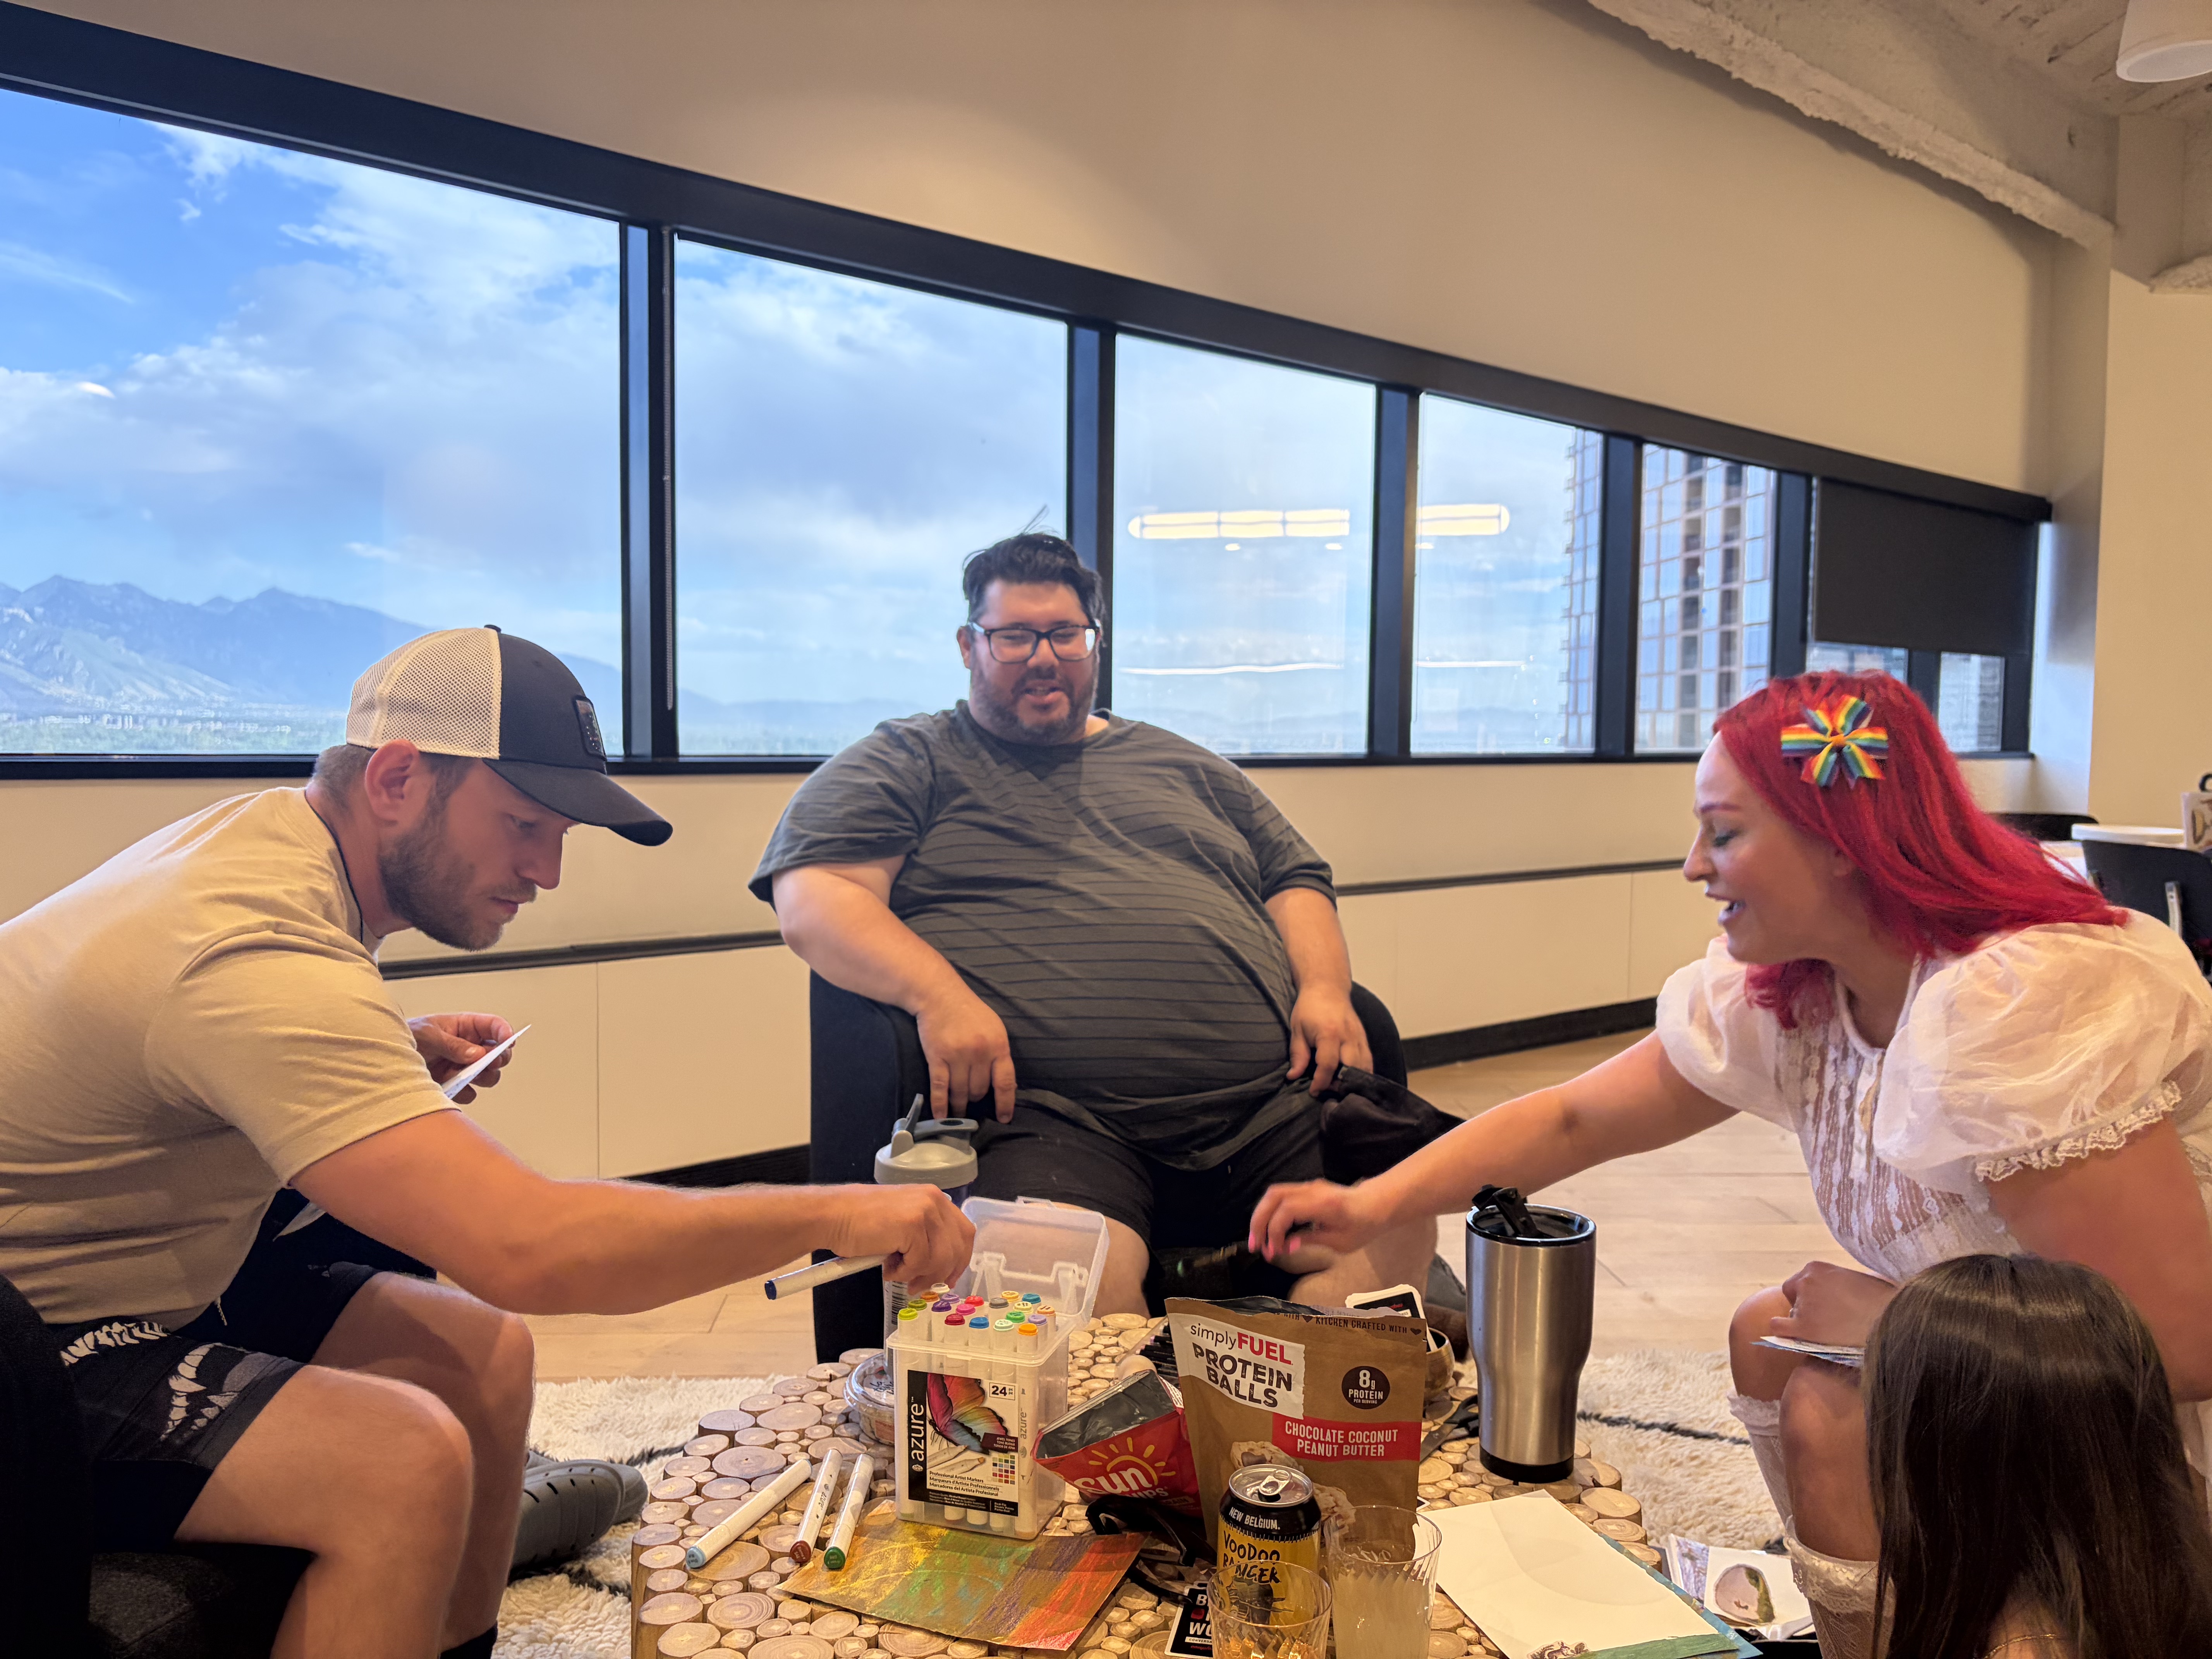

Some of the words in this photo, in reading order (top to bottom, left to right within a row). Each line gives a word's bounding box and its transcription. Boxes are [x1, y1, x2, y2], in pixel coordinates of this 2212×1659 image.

[1316, 1317, 1348, 1328] KITCHEN
[1352, 1320, 1386, 1331] CRAFTED
[1389, 1324, 1407, 1333] WITH
[1192, 1342, 1292, 1391] PROTEIN
[1206, 1366, 1278, 1408] BALLS
[1359, 1370, 1375, 1389] 8g
[991, 1385, 1007, 1396] 24
[1348, 1389, 1383, 1400] PROTEIN
[911, 1403, 924, 1461] azure
[1285, 1420, 1344, 1443] CHOCOLATE
[1348, 1429, 1398, 1443] COCONUT
[1297, 1439, 1338, 1457] PEANUT
[1342, 1444, 1384, 1457] BUTTER
[970, 1482, 1000, 1491] Professionnels
[1229, 1507, 1243, 1522] NEW
[1223, 1530, 1280, 1565] VOODOO
